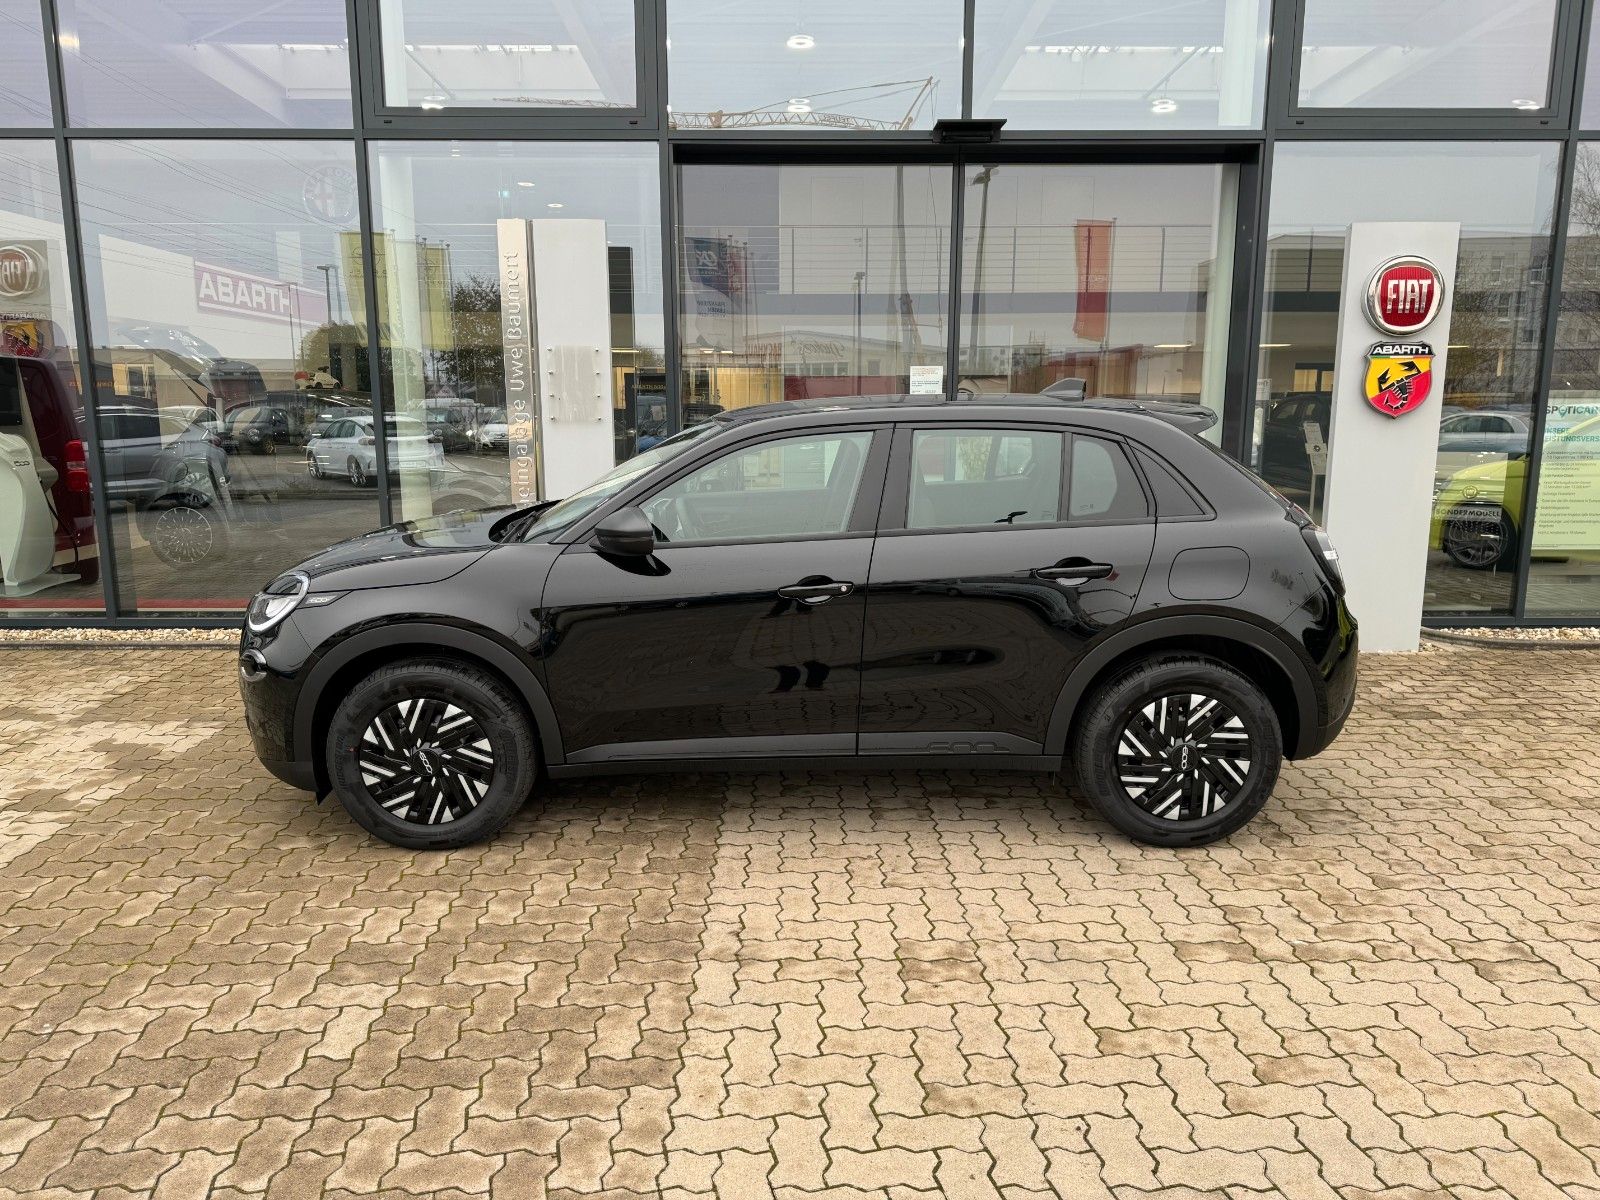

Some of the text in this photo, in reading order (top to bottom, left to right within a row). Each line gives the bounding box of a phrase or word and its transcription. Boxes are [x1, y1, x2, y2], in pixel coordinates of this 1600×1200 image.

[199, 271, 293, 314] ABARTH
[504, 251, 523, 340] Baumert
[1386, 279, 1432, 314] FIAT
[510, 348, 525, 391] Uwe
[1372, 345, 1430, 355] ABARTH
